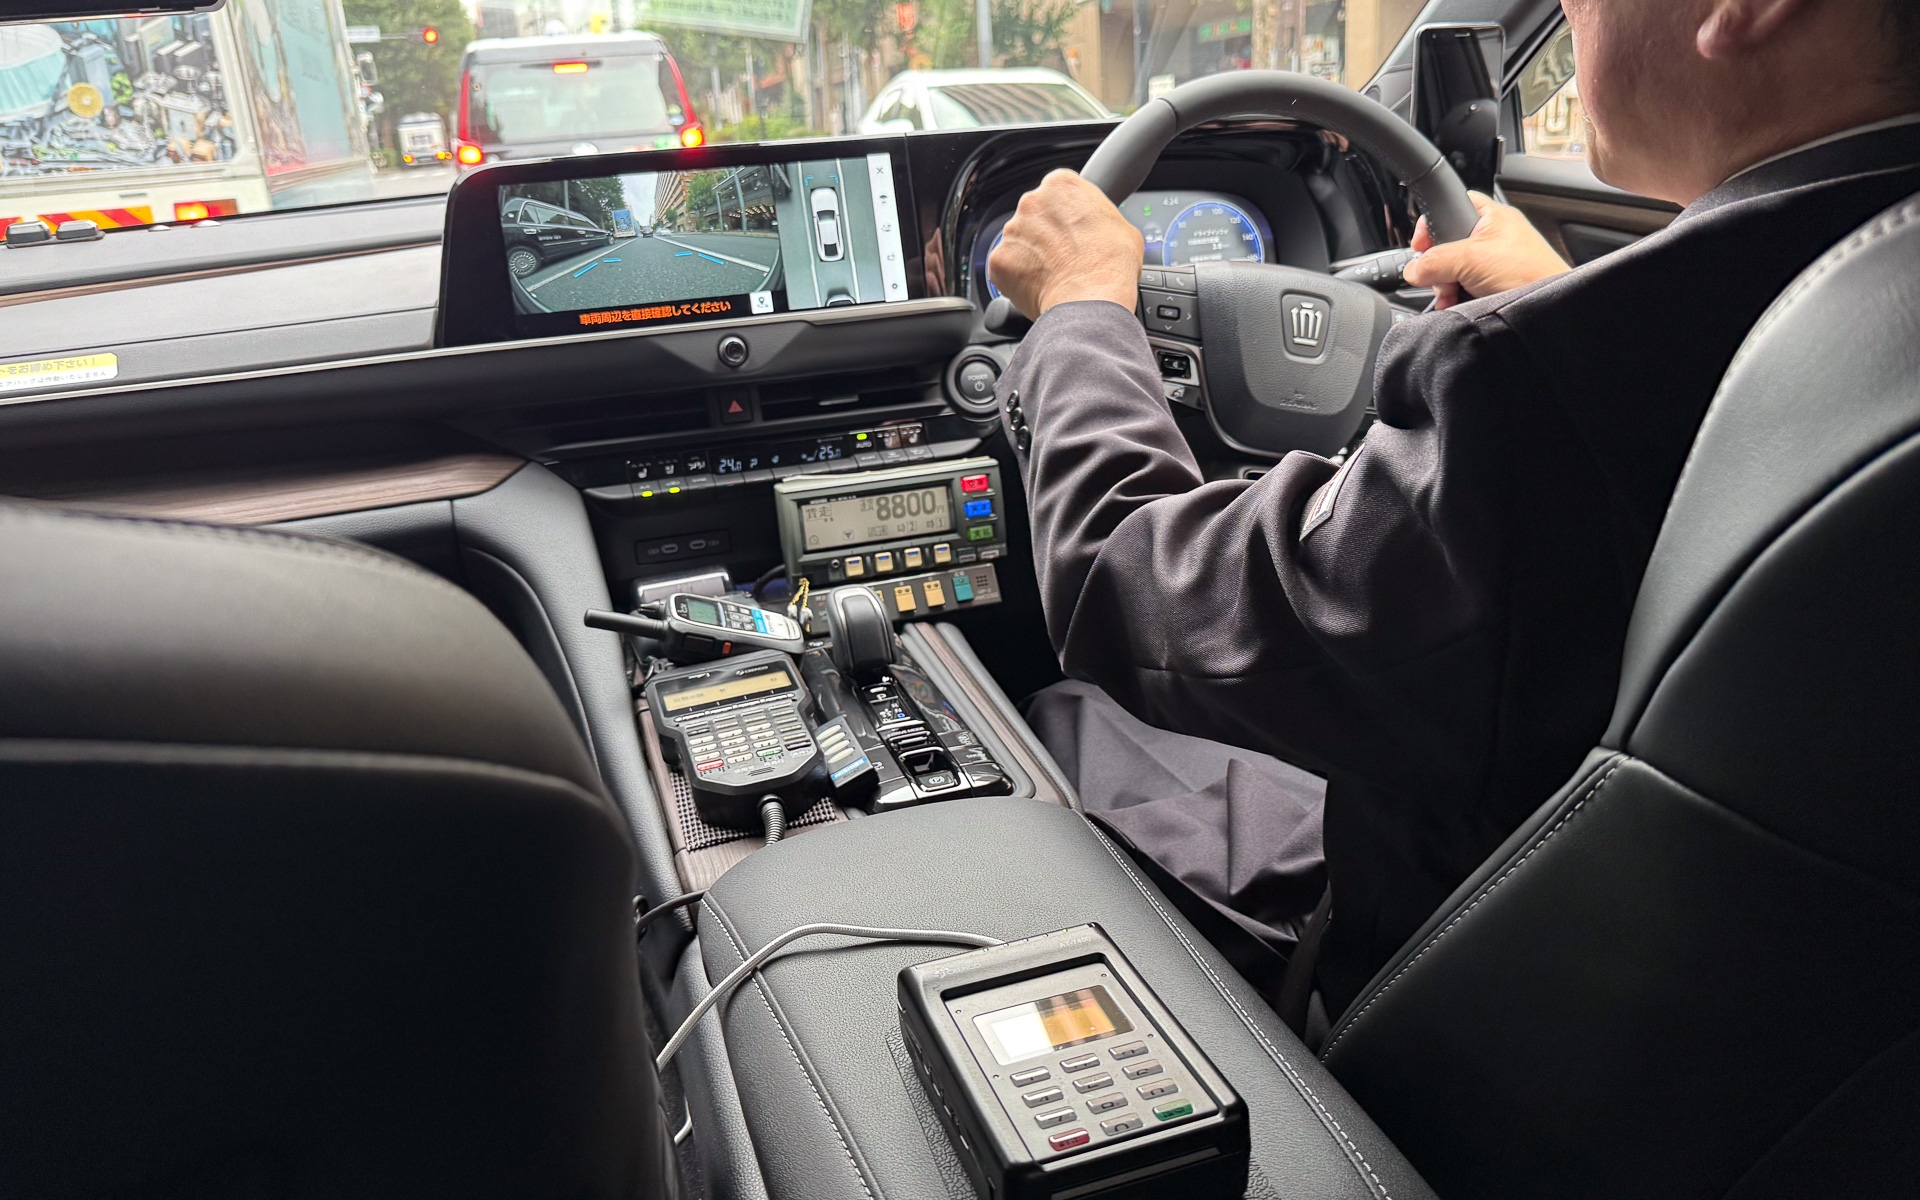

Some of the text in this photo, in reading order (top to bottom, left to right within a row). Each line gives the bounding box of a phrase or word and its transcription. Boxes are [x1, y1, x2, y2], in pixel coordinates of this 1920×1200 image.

[579, 301, 731, 325] 車両周辺を直接確認してください
[876, 489, 937, 522] 8800
